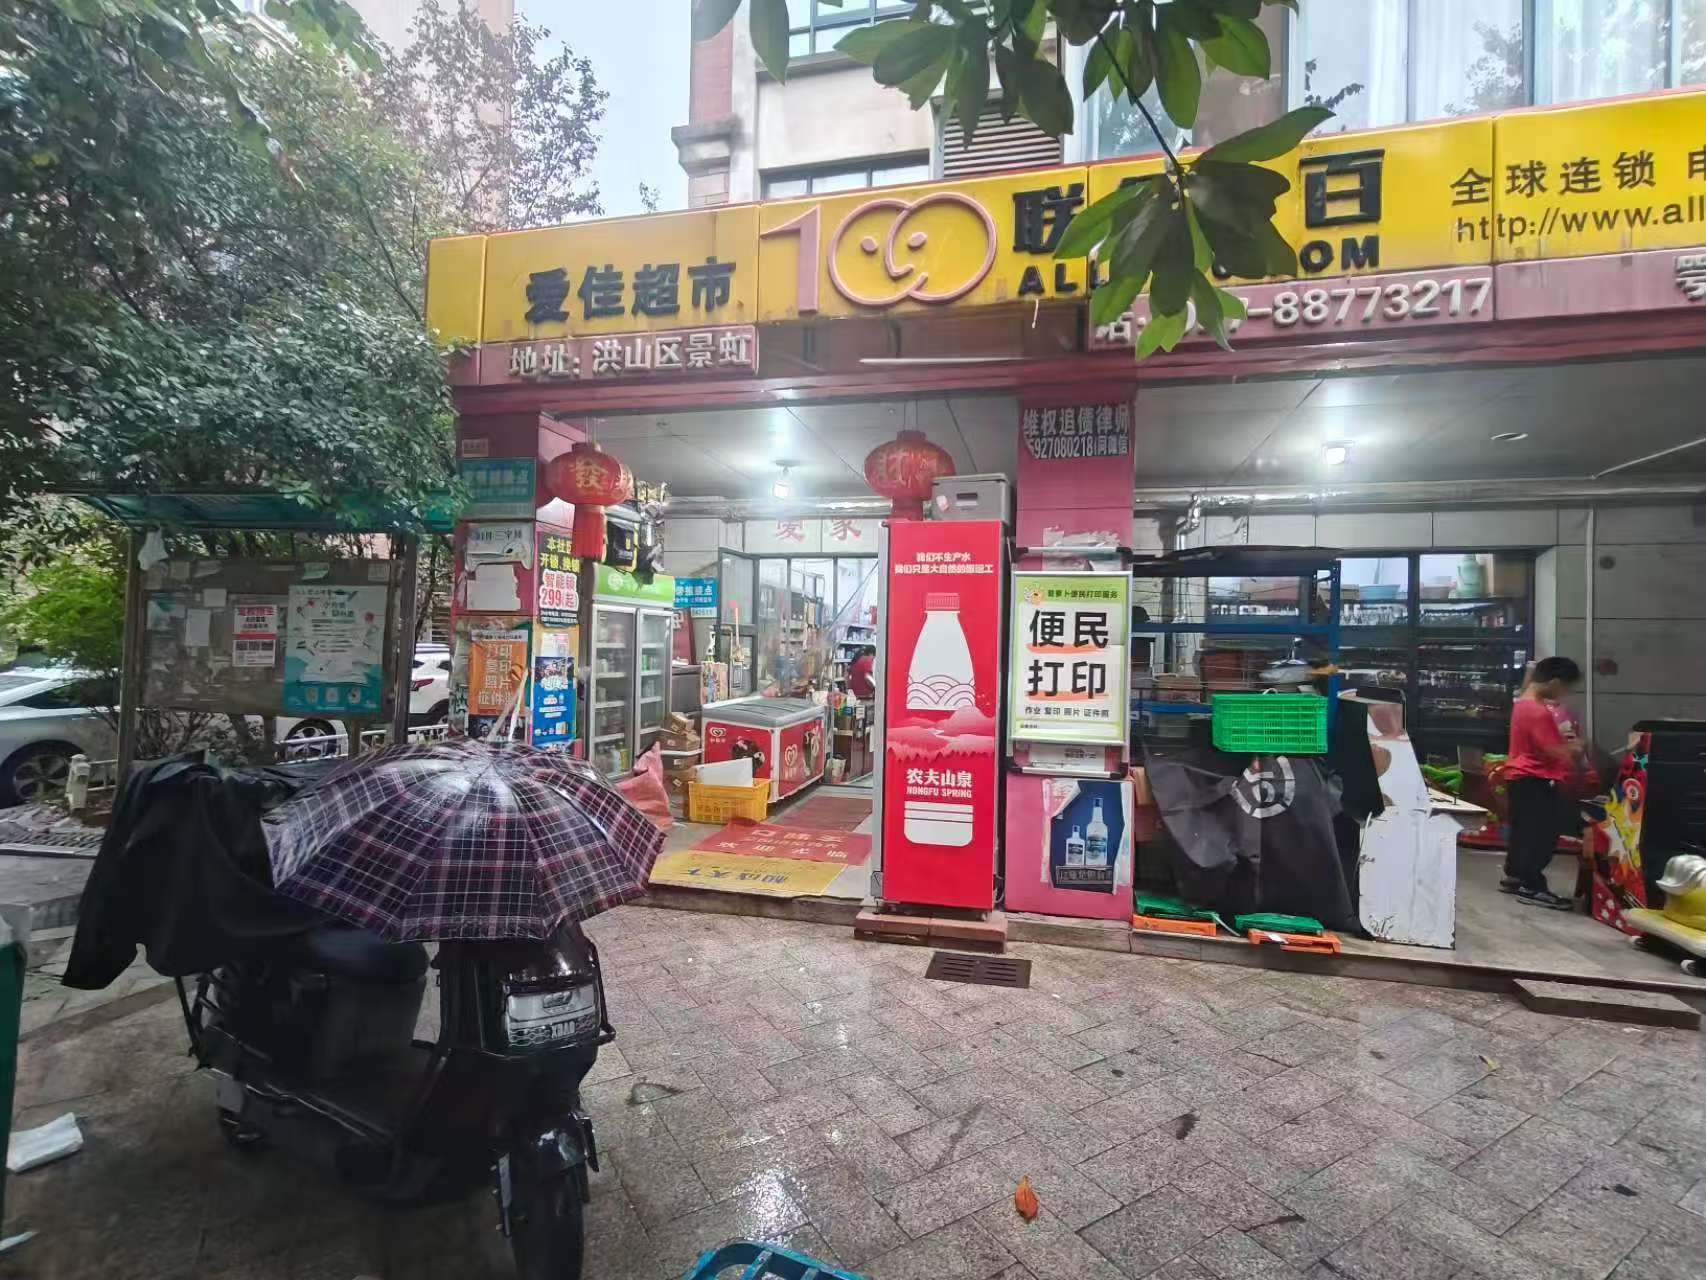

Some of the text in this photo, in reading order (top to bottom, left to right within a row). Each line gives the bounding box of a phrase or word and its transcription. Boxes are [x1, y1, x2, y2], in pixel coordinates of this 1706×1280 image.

[1450, 151, 1657, 207] 全球连锁
[525, 256, 736, 322] 爱佳超市
[916, 551, 972, 562] 我们不生产水
[1029, 609, 1110, 649] 便民
[1027, 658, 1107, 699] 打印
[1025, 705, 1041, 716] 作业
[1044, 706, 1061, 717] 复印
[906, 767, 973, 788] 农夫山泉
[906, 785, 973, 799] NONGFU SPRING
